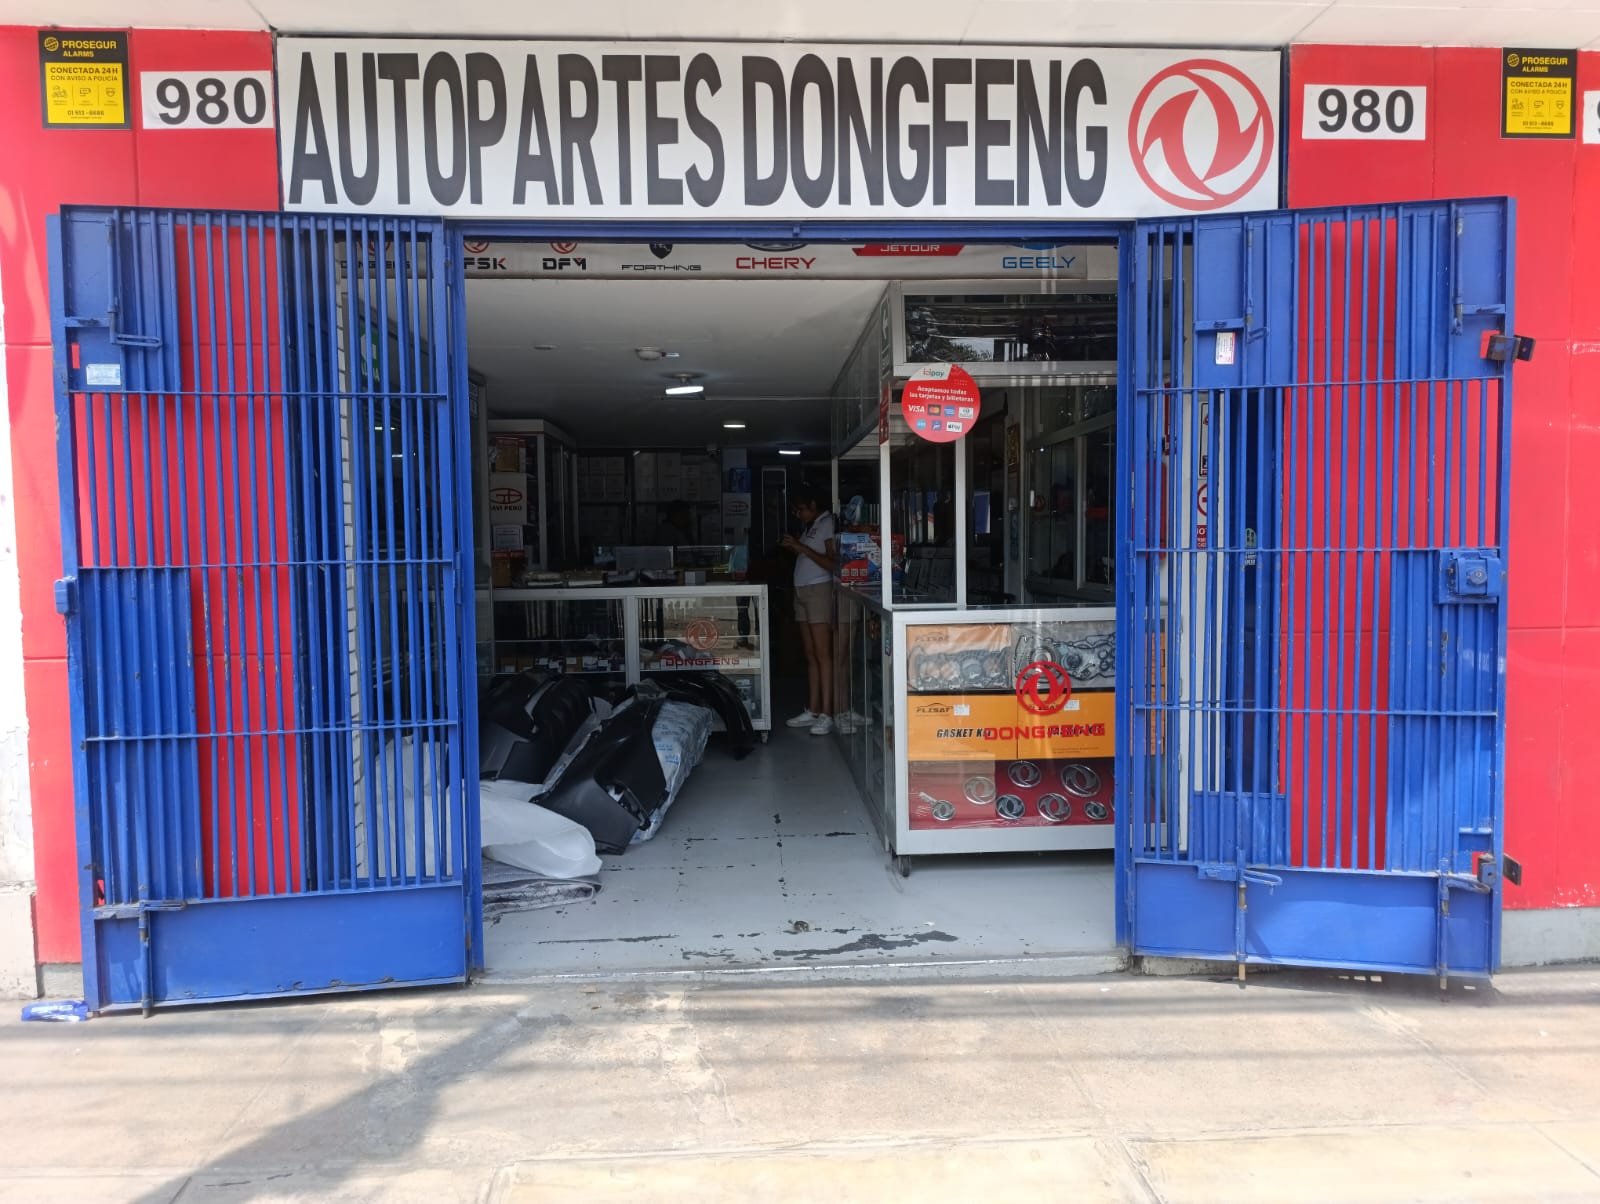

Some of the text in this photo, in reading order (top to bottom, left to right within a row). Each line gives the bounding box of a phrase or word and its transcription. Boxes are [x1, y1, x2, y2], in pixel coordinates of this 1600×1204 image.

[62, 40, 117, 49] PROSEGUR
[1522, 56, 1568, 65] PROSEGUR
[156, 78, 267, 125] 980
[1318, 88, 1415, 134] 980
[289, 51, 1108, 208] AUTOPARTES DONGFENG
[880, 244, 940, 252] JETOUR
[735, 257, 817, 270] CHERY
[1002, 256, 1076, 269] GEELY
[621, 264, 702, 272] FORTHING
[917, 385, 949, 394] Aceptamos
[908, 404, 925, 413] VISA
[665, 656, 740, 667] DONGFENG
[936, 729, 974, 738] GASKET
[983, 723, 1106, 740] DONGFENG
